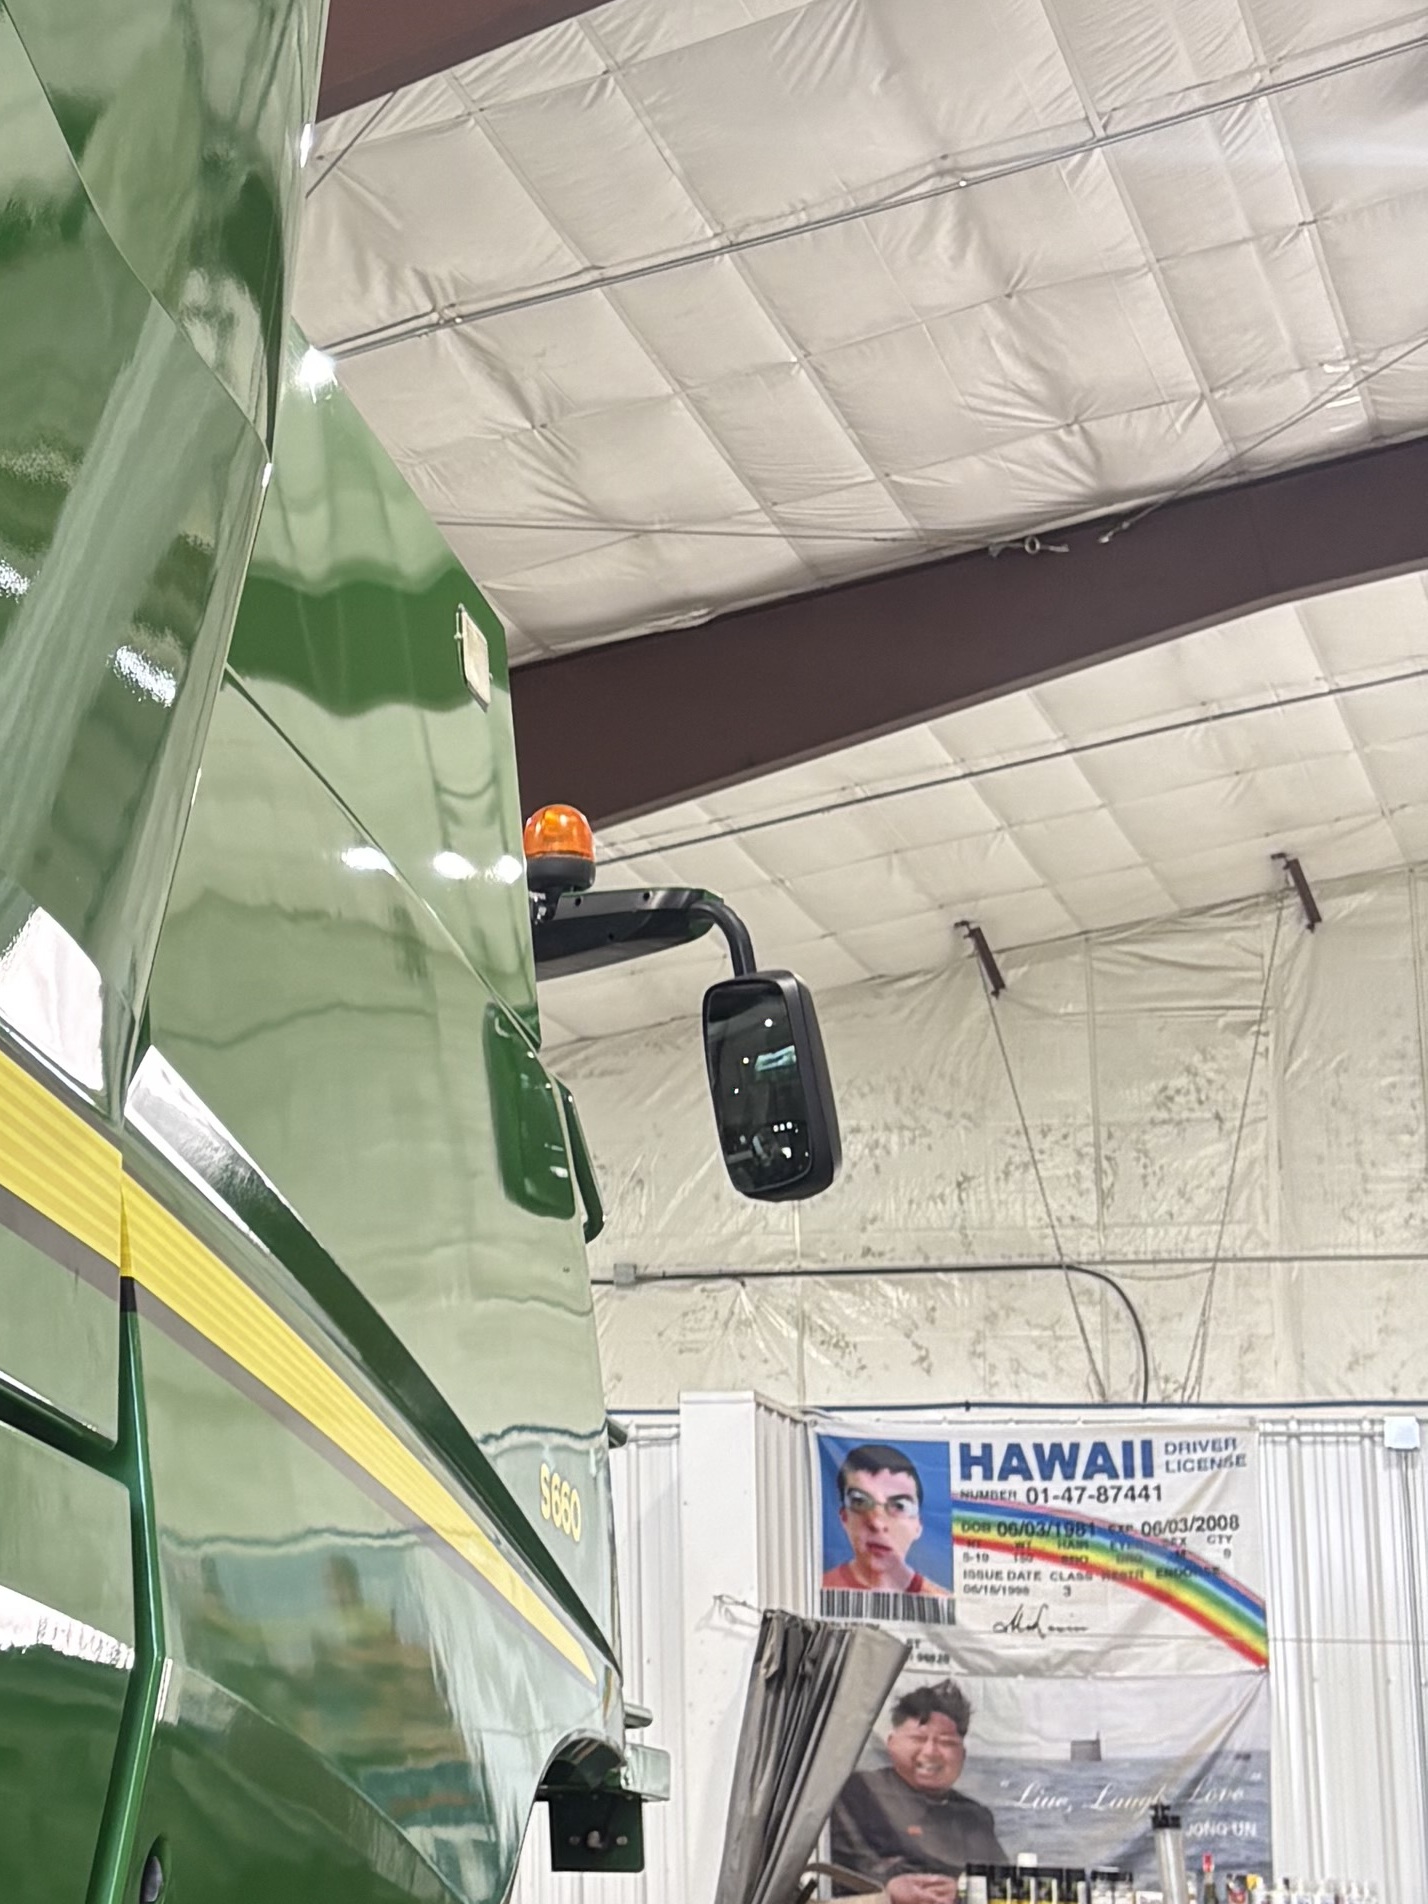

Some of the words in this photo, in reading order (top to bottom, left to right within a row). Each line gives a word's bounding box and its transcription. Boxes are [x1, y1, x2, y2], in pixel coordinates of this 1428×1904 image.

[1164, 1437, 1237, 1456] DRIVER
[959, 1440, 1155, 1481] HAWAII
[1164, 1453, 1248, 1474] LICENSE
[540, 1462, 582, 1543] S660
[959, 1488, 1018, 1501] NUMBER
[1024, 1483, 1163, 1505] 01-47-87441
[961, 1521, 992, 1533] DOB
[996, 1519, 1097, 1538] 06/03/1981
[1141, 1514, 1241, 1537] 06/03/2008
[1206, 1534, 1233, 1544] CTY
[963, 1569, 1004, 1581] ISSUE
[1007, 1570, 1042, 1582] DATE
[1049, 1571, 1094, 1582] CLASS
